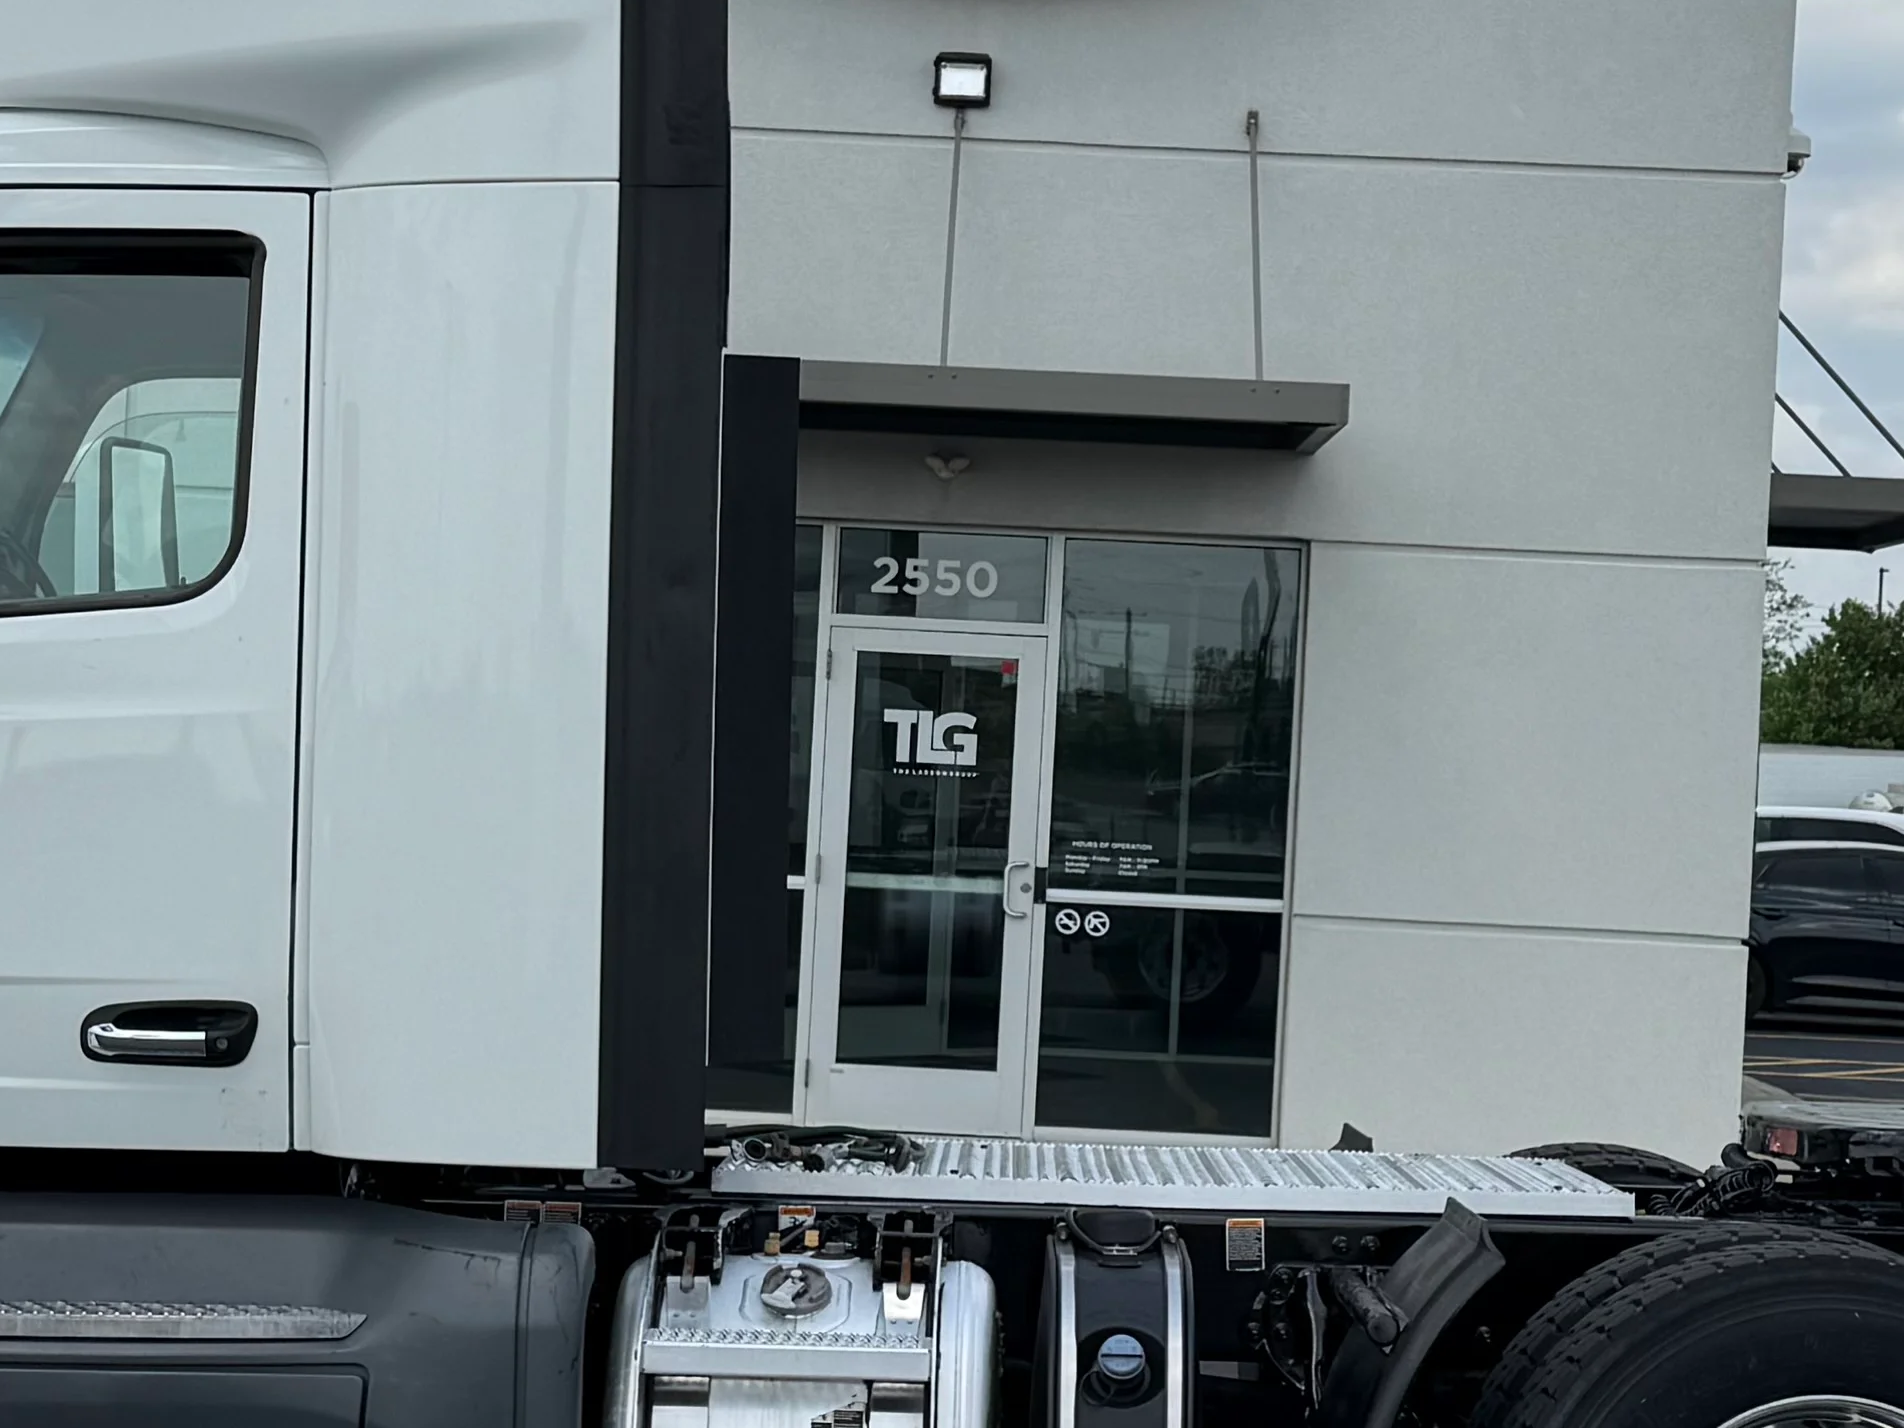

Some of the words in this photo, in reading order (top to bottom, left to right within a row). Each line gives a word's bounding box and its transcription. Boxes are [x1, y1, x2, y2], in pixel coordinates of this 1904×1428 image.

[870, 556, 998, 598] 2550
[884, 708, 978, 766] TLG
[1111, 842, 1153, 851] OPERATION
